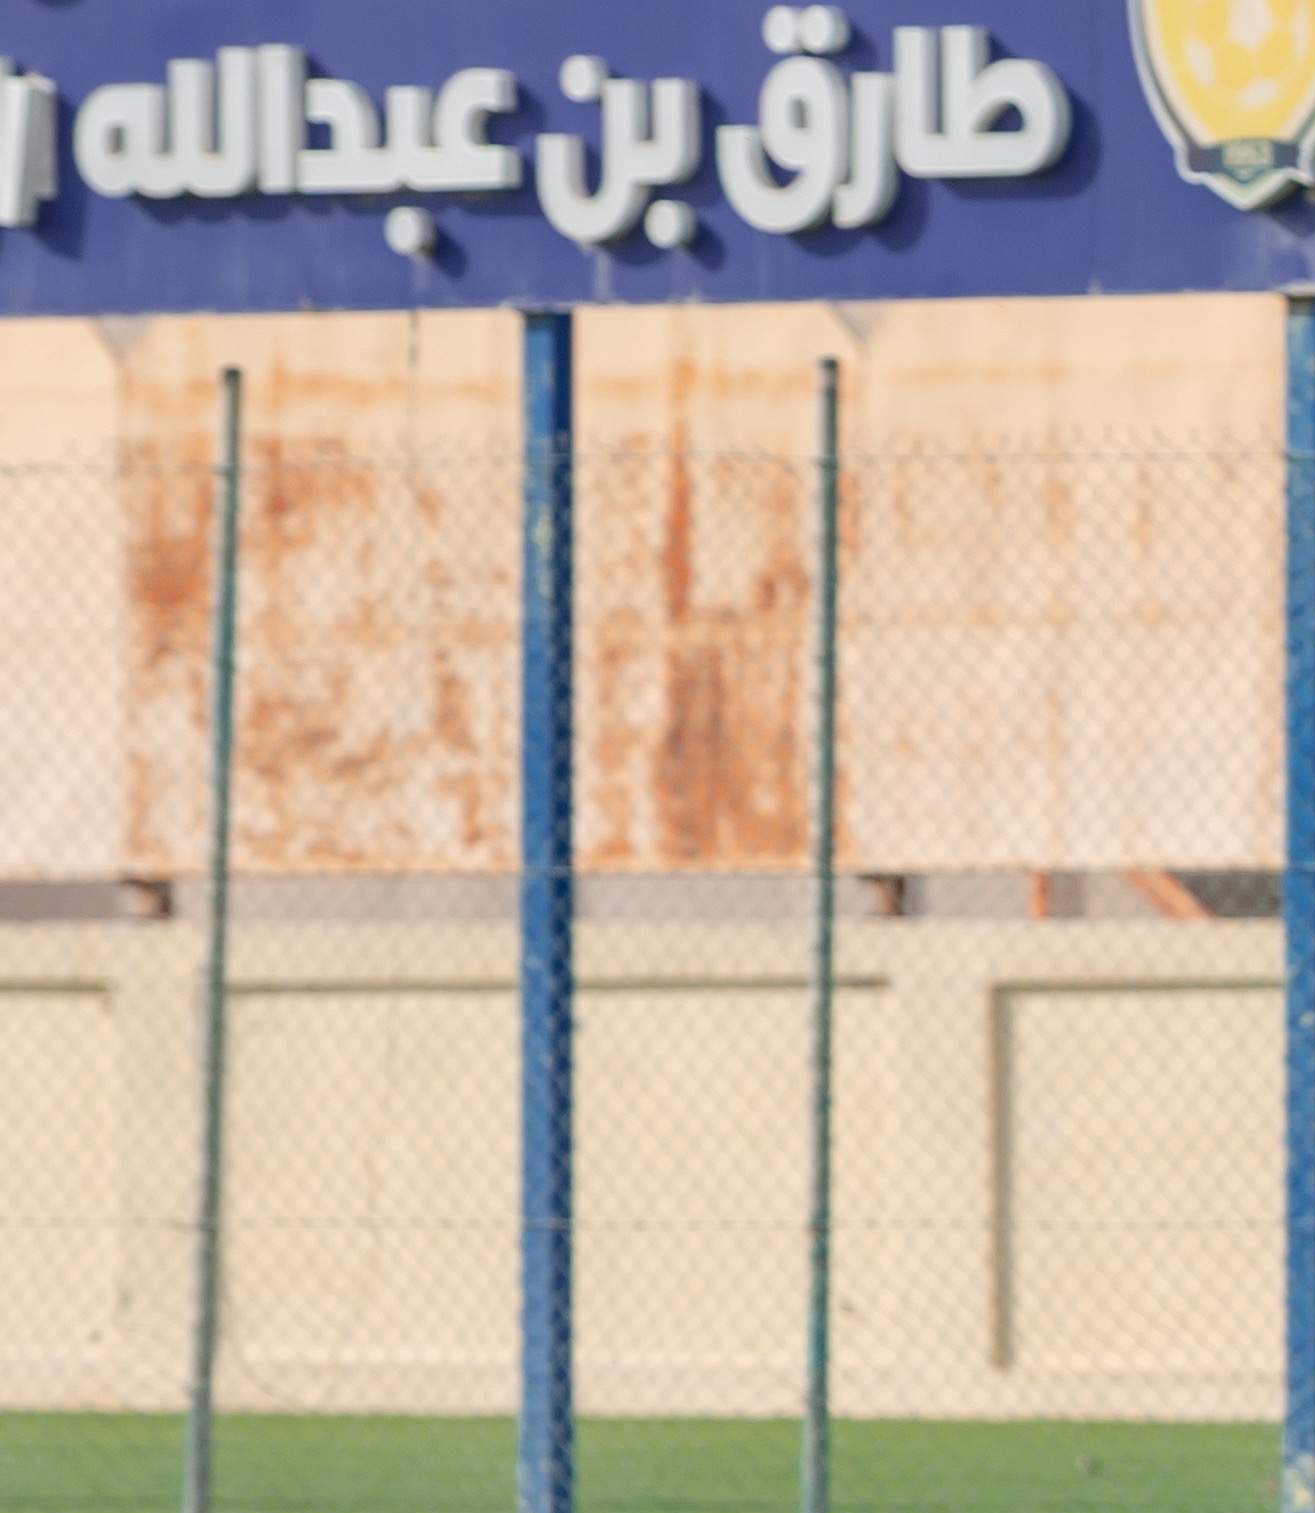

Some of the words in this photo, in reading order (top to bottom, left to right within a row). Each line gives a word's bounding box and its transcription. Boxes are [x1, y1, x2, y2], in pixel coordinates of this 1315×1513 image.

[74, 44, 522, 255] عبدالله
[536, 54, 698, 249] بن
[716, 4, 1071, 233] طارق
